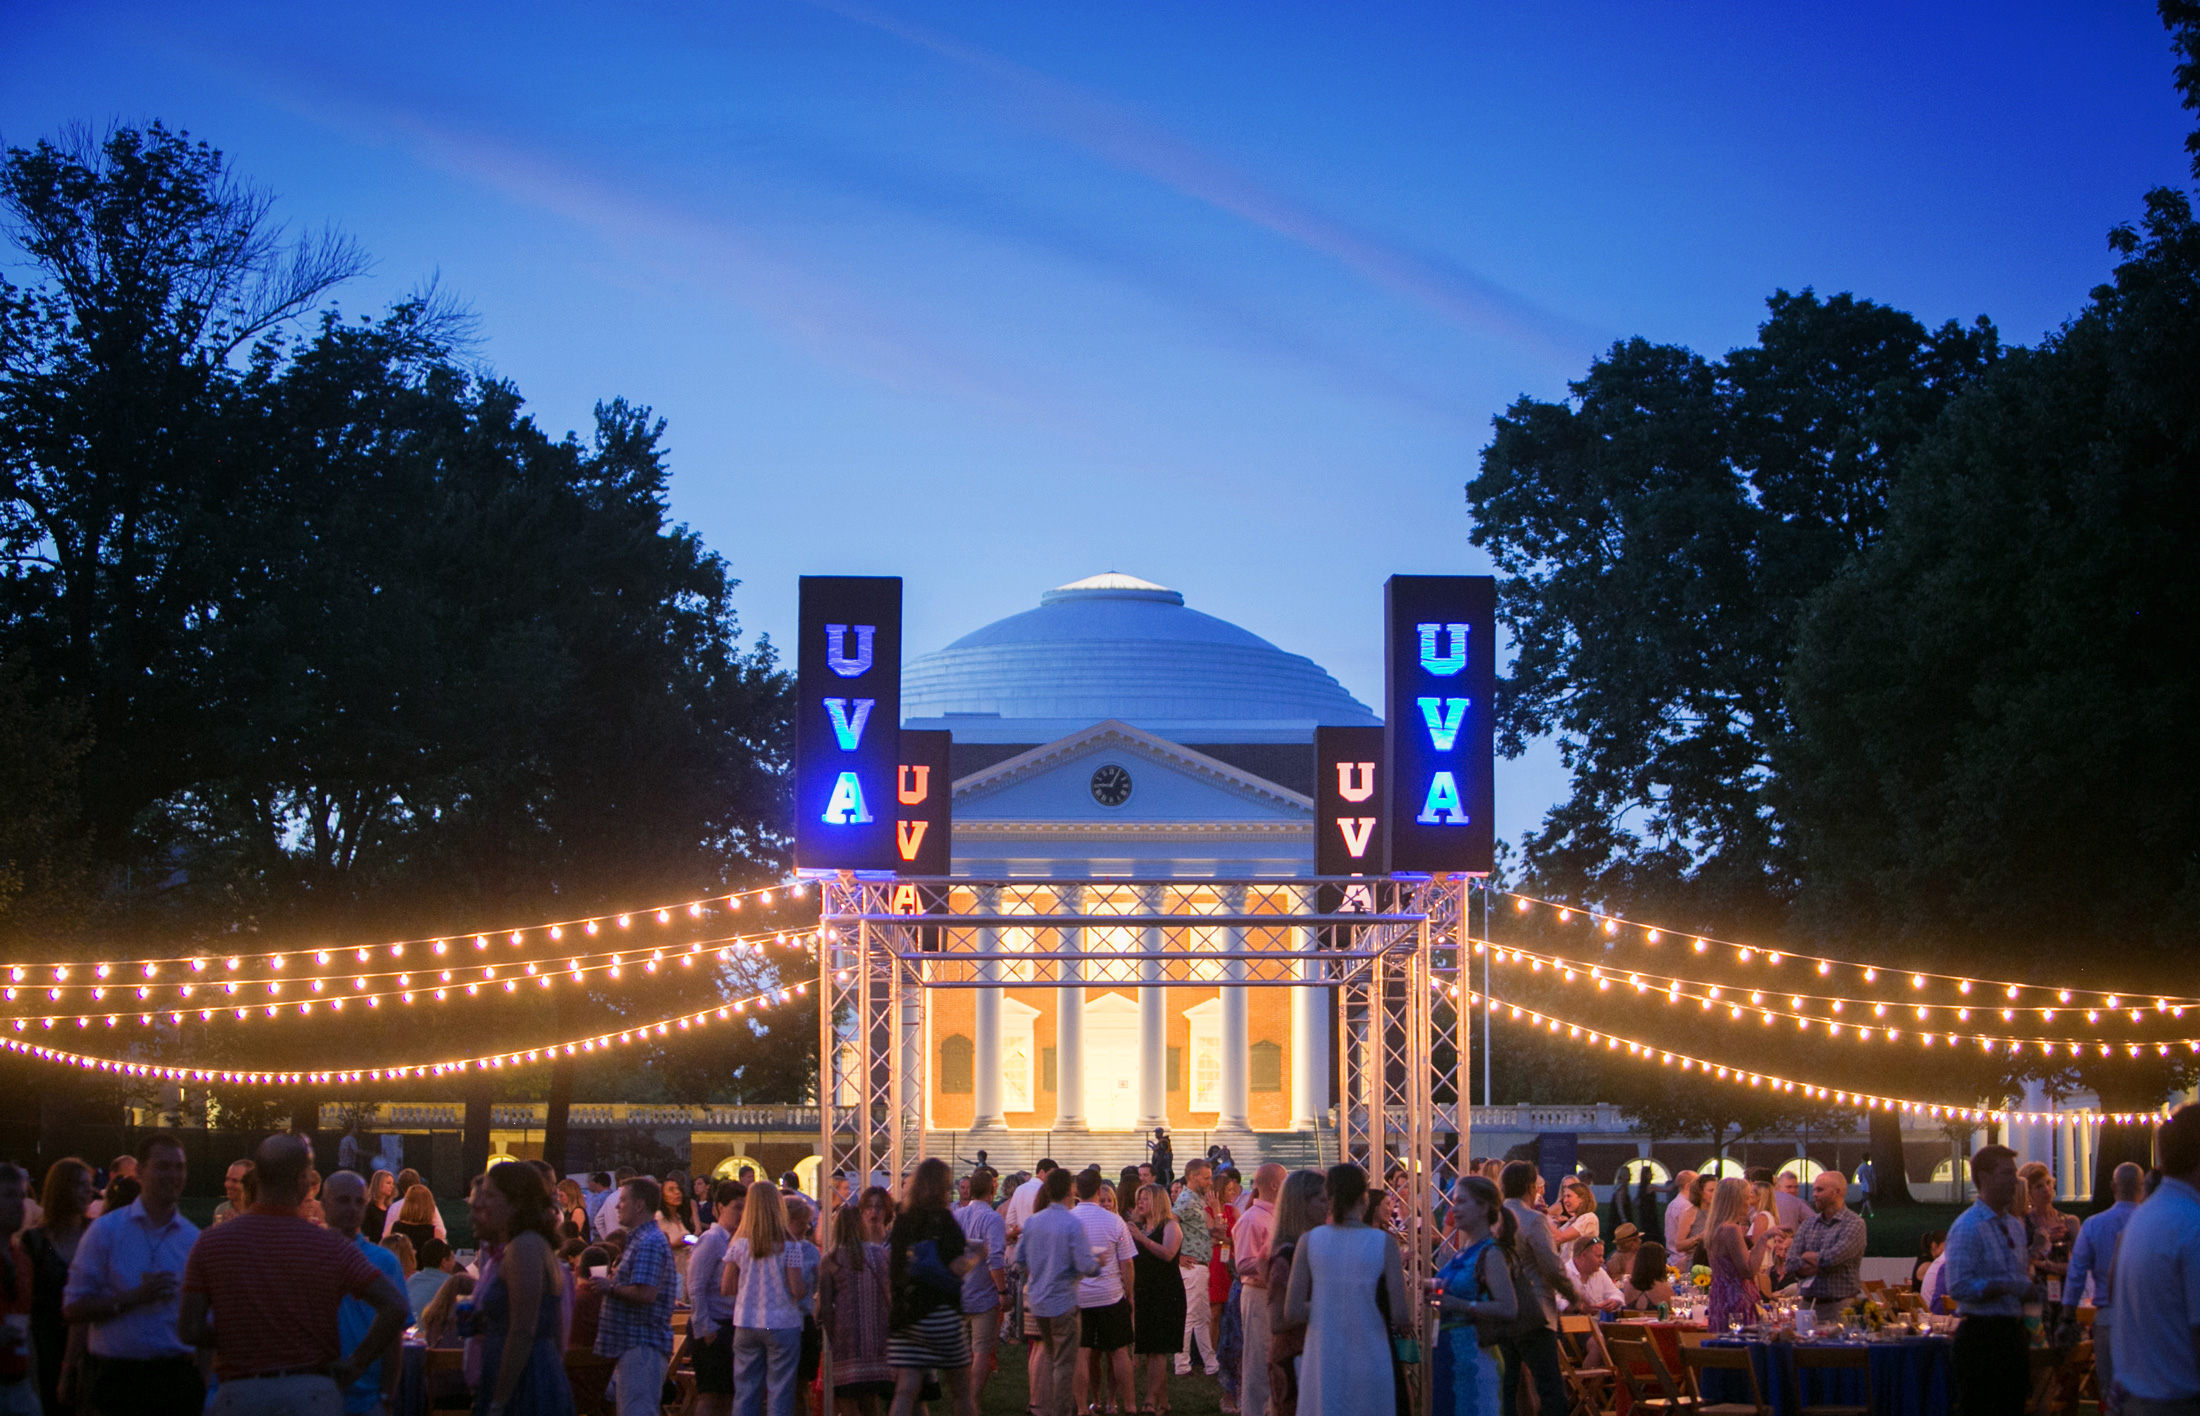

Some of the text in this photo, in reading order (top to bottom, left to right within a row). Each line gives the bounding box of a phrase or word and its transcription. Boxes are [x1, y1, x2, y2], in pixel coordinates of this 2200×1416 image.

[822, 623, 876, 824] UVA
[1416, 623, 1471, 824] UVA
[892, 764, 930, 915] UVA
[1336, 762, 1376, 912] UVA
